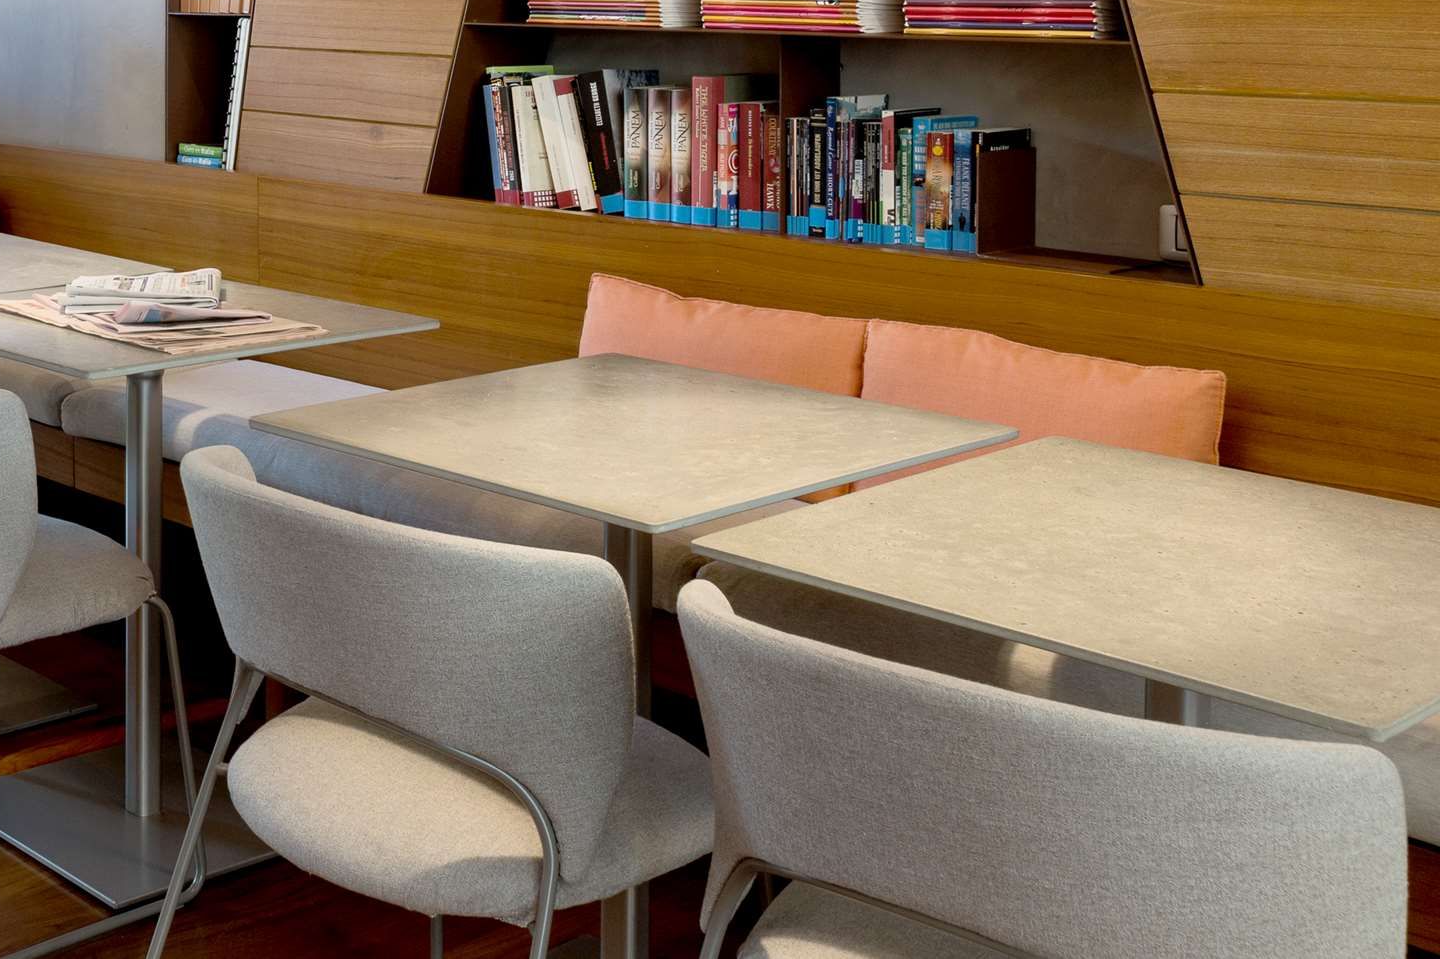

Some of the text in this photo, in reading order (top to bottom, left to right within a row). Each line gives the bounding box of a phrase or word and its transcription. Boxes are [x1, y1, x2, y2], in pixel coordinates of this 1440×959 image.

[589, 81, 603, 126] ELIZABETH GEORGE
[700, 86, 708, 107] THE
[629, 109, 643, 148] PANEM
[653, 111, 666, 150] PANEM
[676, 112, 689, 152] PANEM
[768, 117, 776, 156] COURTENAY
[765, 182, 774, 209] HAWK
[961, 157, 969, 209] FRANK DELANEY
